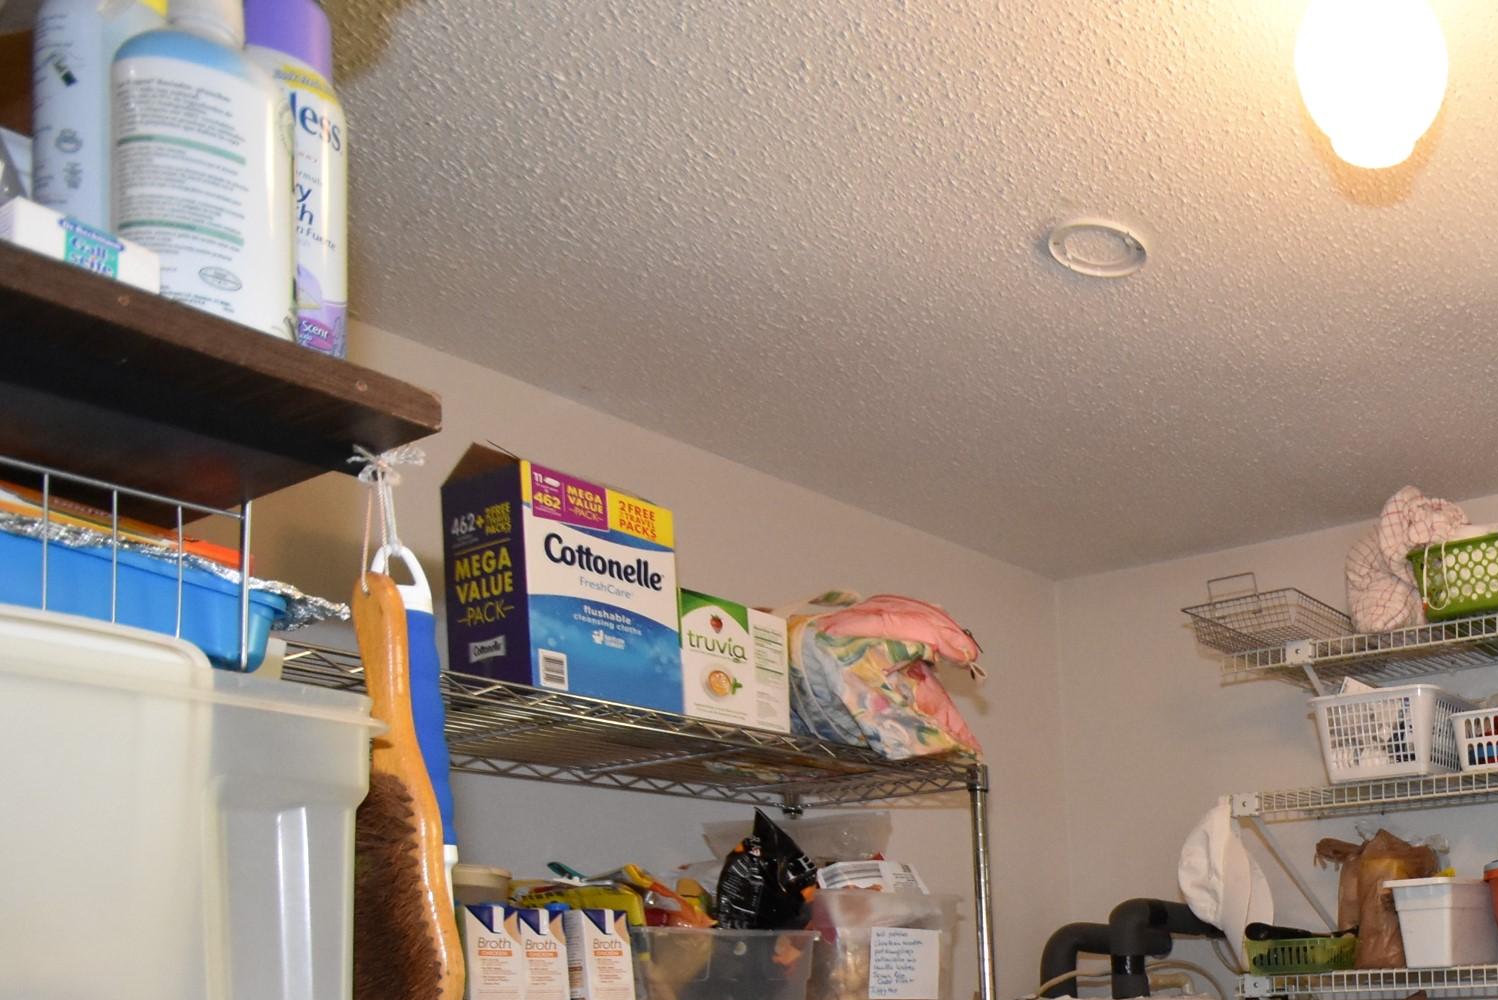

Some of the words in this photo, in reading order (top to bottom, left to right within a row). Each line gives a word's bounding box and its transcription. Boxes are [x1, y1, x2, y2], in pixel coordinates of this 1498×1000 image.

[302, 319, 328, 340] Scent
[534, 492, 561, 509] 462
[566, 485, 602, 503] MEGA
[567, 495, 603, 513] VALUE
[619, 519, 657, 540] PACKS
[454, 546, 512, 582] MEGA
[544, 532, 663, 591] Cottonelle
[456, 571, 513, 604] VALUE
[579, 576, 631, 599] FreshCare
[583, 604, 631, 625] flushable
[477, 936, 512, 949] Broth
[525, 938, 557, 951] Broth
[592, 938, 622, 951] Broth
